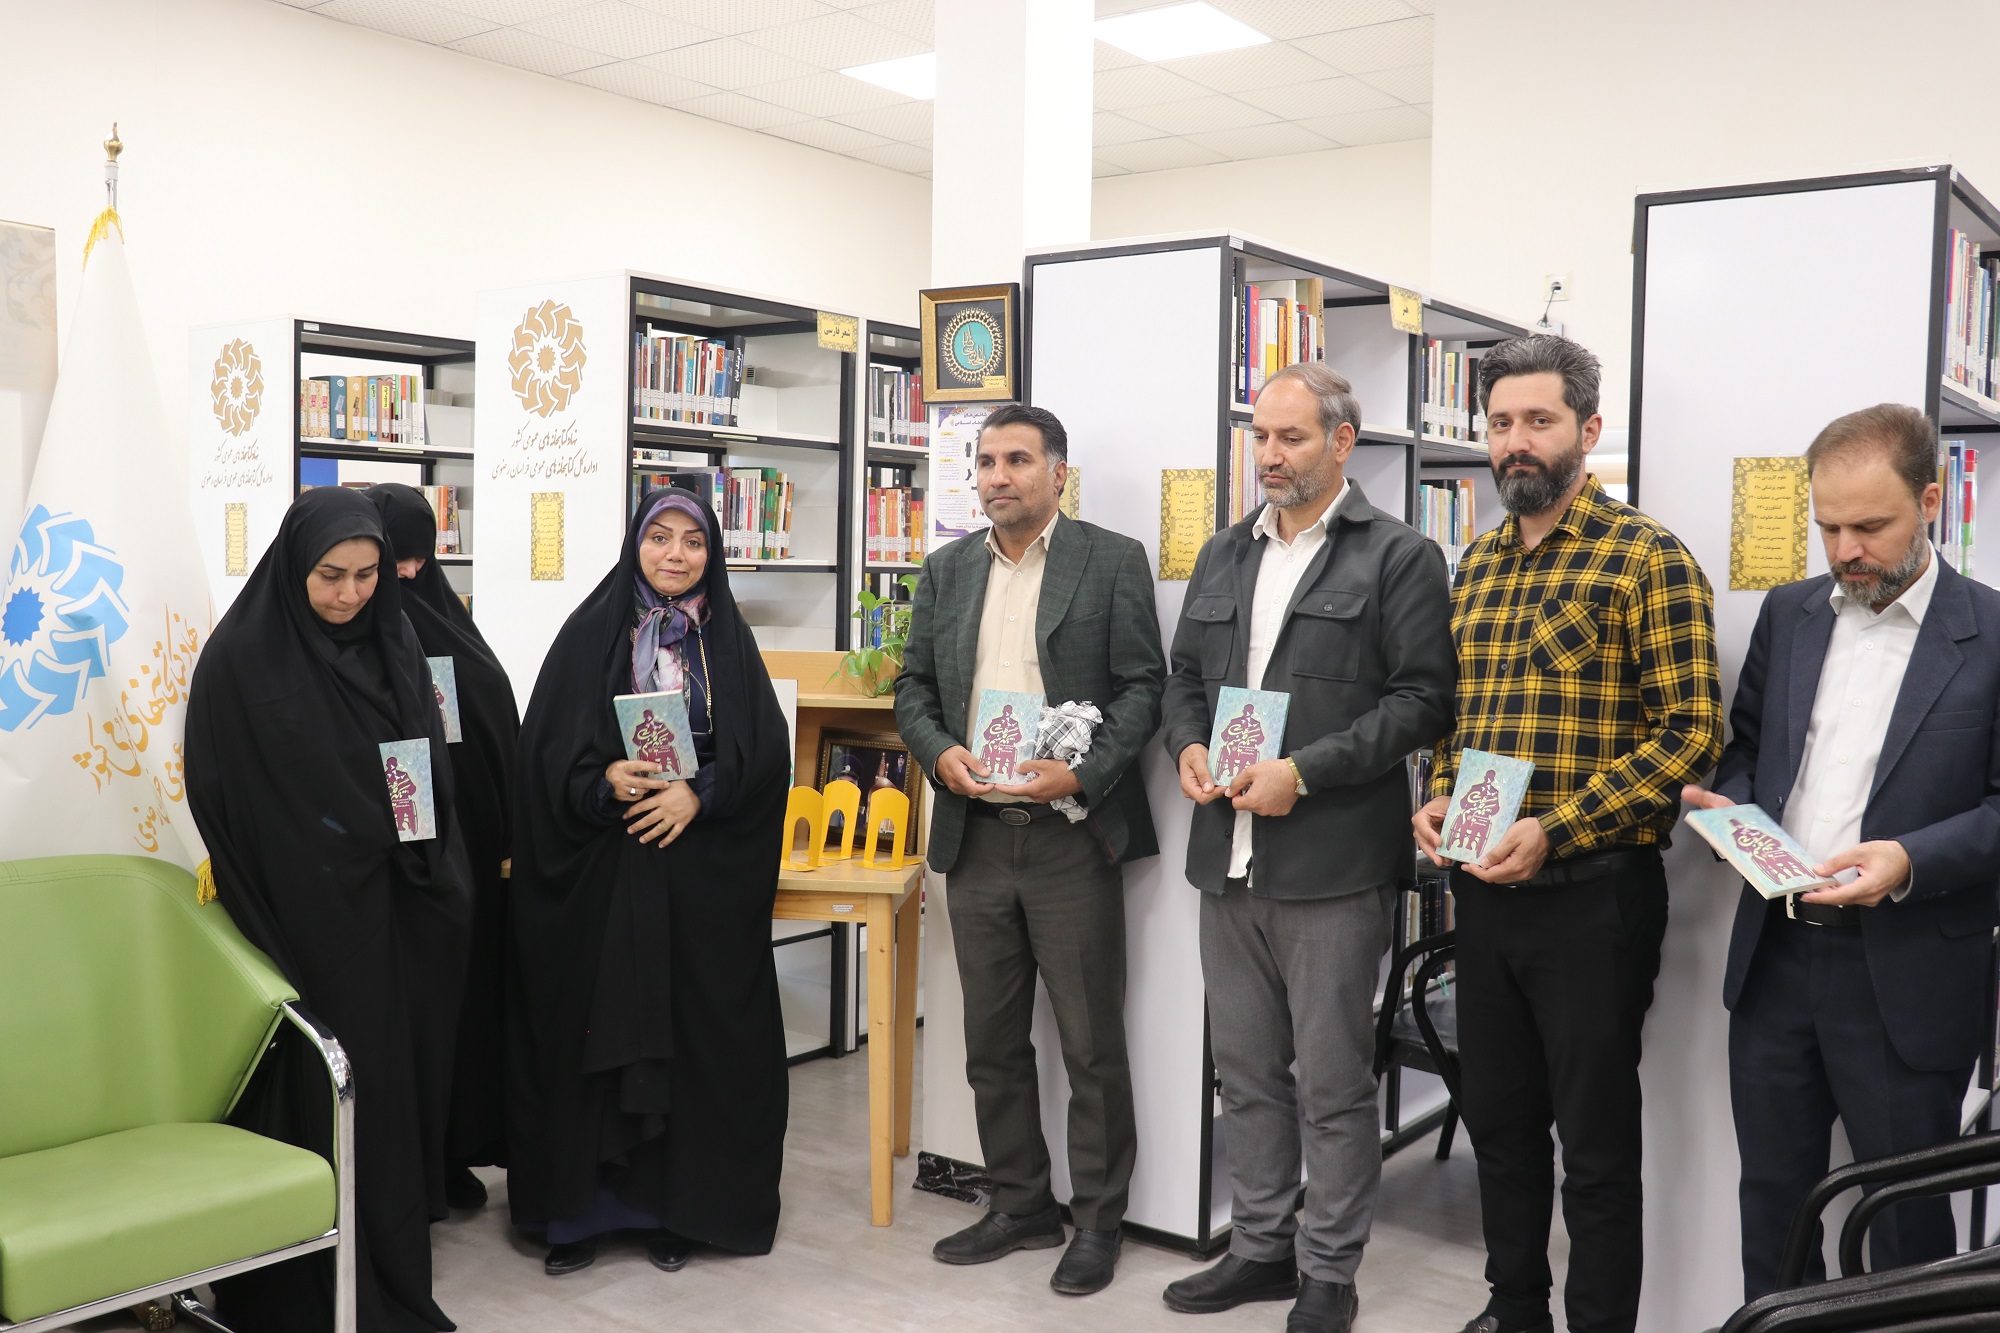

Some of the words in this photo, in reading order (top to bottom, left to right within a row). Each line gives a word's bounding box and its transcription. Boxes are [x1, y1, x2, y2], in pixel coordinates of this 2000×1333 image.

[824, 326, 840, 337] فارسی
[841, 329, 851, 338] شعر
[511, 419, 531, 448] کشور
[522, 431, 539, 451] عمومی
[491, 458, 511, 480] رضوی
[509, 456, 530, 479] خراسان
[529, 459, 546, 479] عمومی
[573, 450, 588, 478] کل
[583, 460, 598, 474] اداره
[72, 711, 113, 795] کشور
